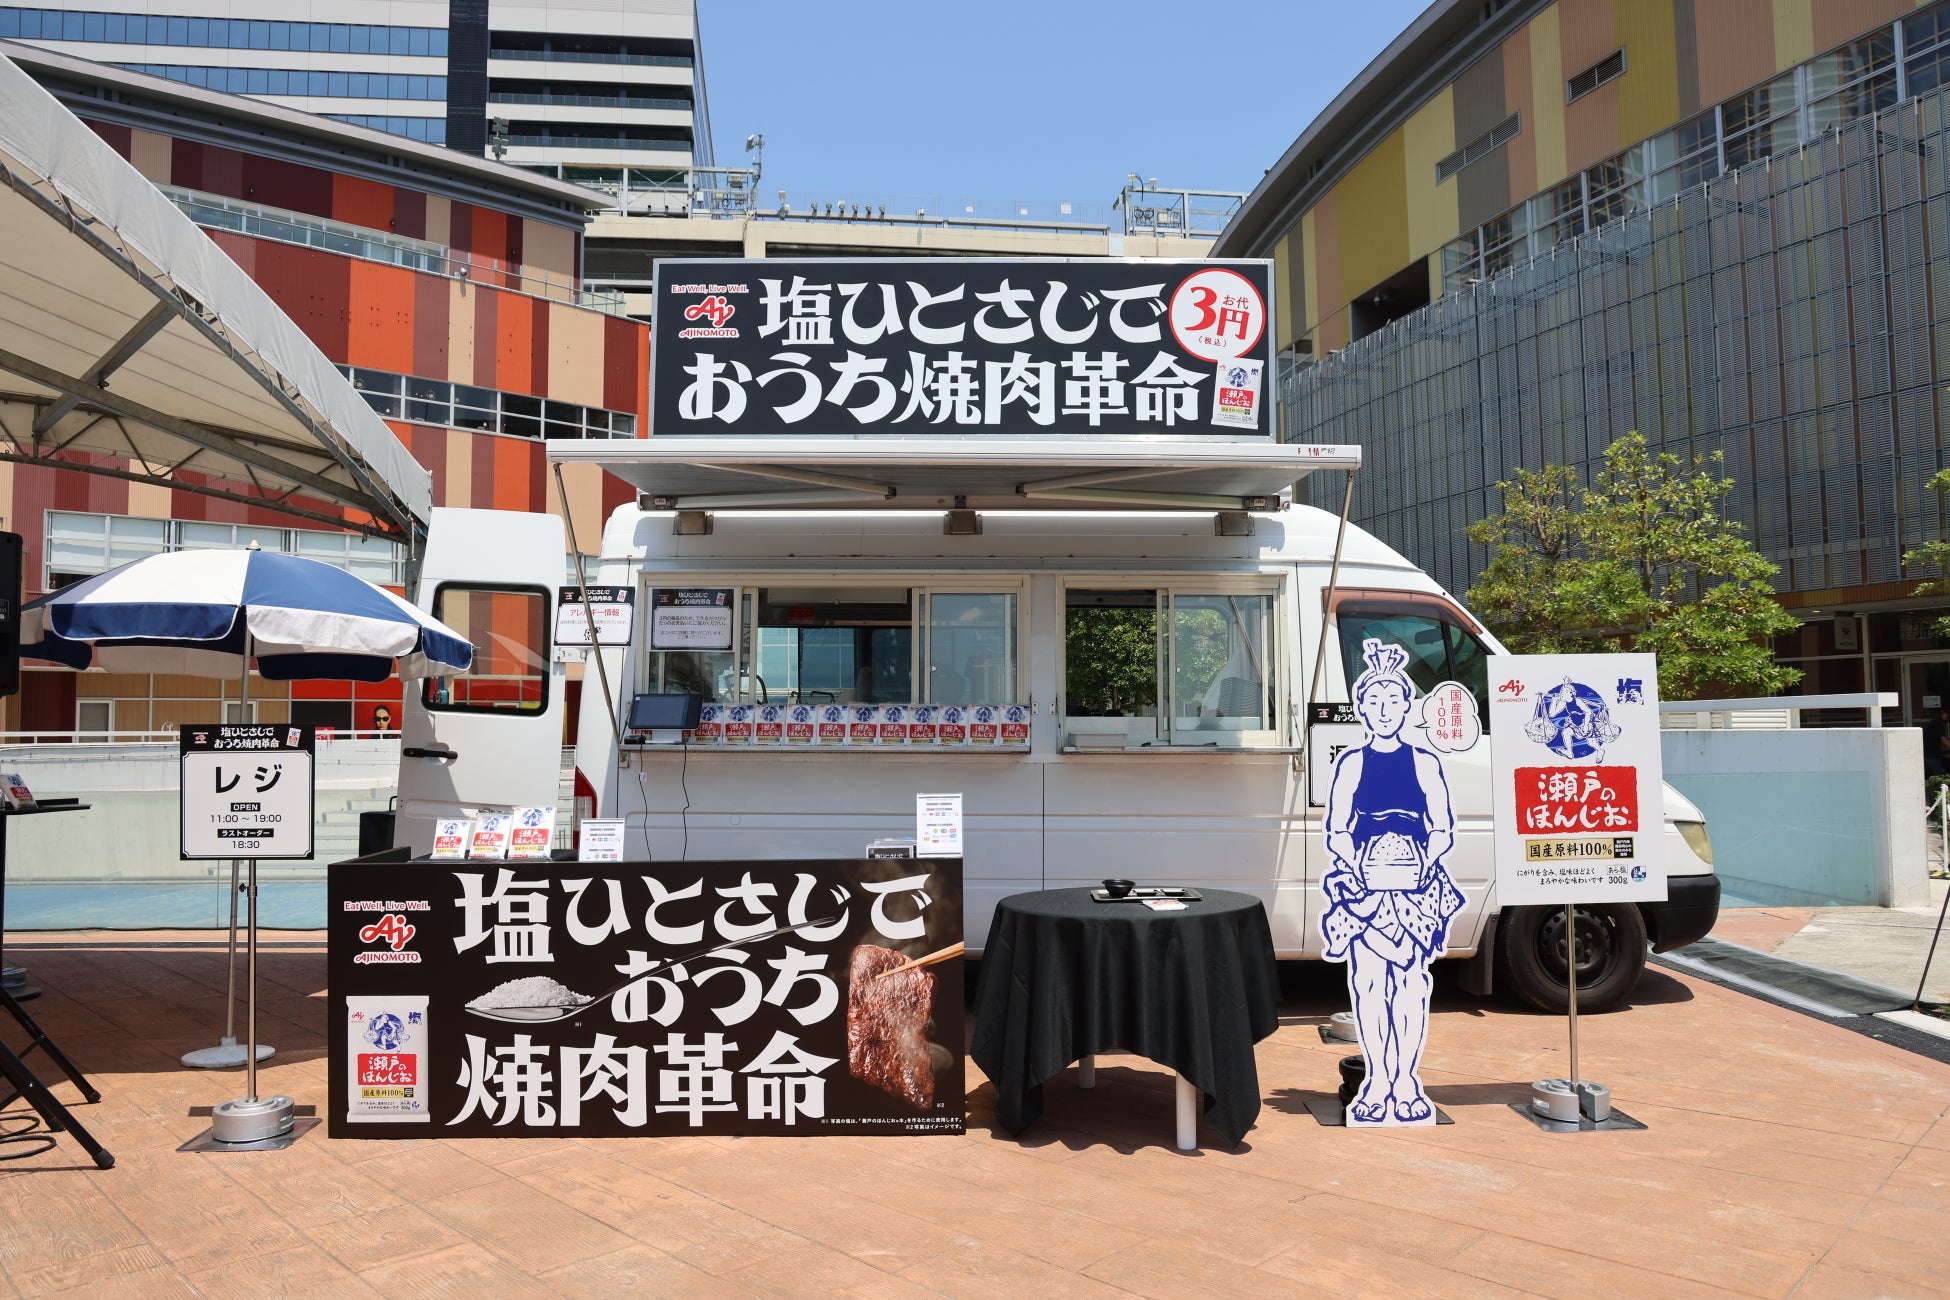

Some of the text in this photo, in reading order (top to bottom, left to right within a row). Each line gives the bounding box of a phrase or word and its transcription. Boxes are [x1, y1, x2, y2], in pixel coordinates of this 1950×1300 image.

[672, 285, 686, 293] Eat
[709, 285, 727, 293] Live
[1222, 295, 1249, 309] お代
[758, 275, 1167, 346] 塩ひとさじで
[678, 350, 1210, 427] おうち焼肉革命
[1436, 697, 1448, 740] 100%
[1450, 689, 1463, 740] 国産原料
[220, 727, 275, 737] 塩ひとさじで
[213, 738, 280, 749] おうち焼肉革命
[216, 764, 282, 793] レジ
[1538, 771, 1616, 803] 瀬戸の
[211, 815, 239, 823] 11:00
[254, 815, 282, 823] 19:00
[232, 840, 260, 849] 18:30
[1530, 842, 1613, 858] 国産原料100%
[1540, 876, 1604, 886] まろやかな味わいです
[1608, 875, 1628, 884] 300g
[345, 902, 430, 911] Eat Well, Live Well.
[452, 868, 933, 964] 塩ひとさじで
[610, 944, 839, 1028] おうち
[368, 1055, 407, 1071] 瀬戸の
[362, 1071, 413, 1083] ほんじお
[445, 1030, 841, 1127] 焼肉革命
